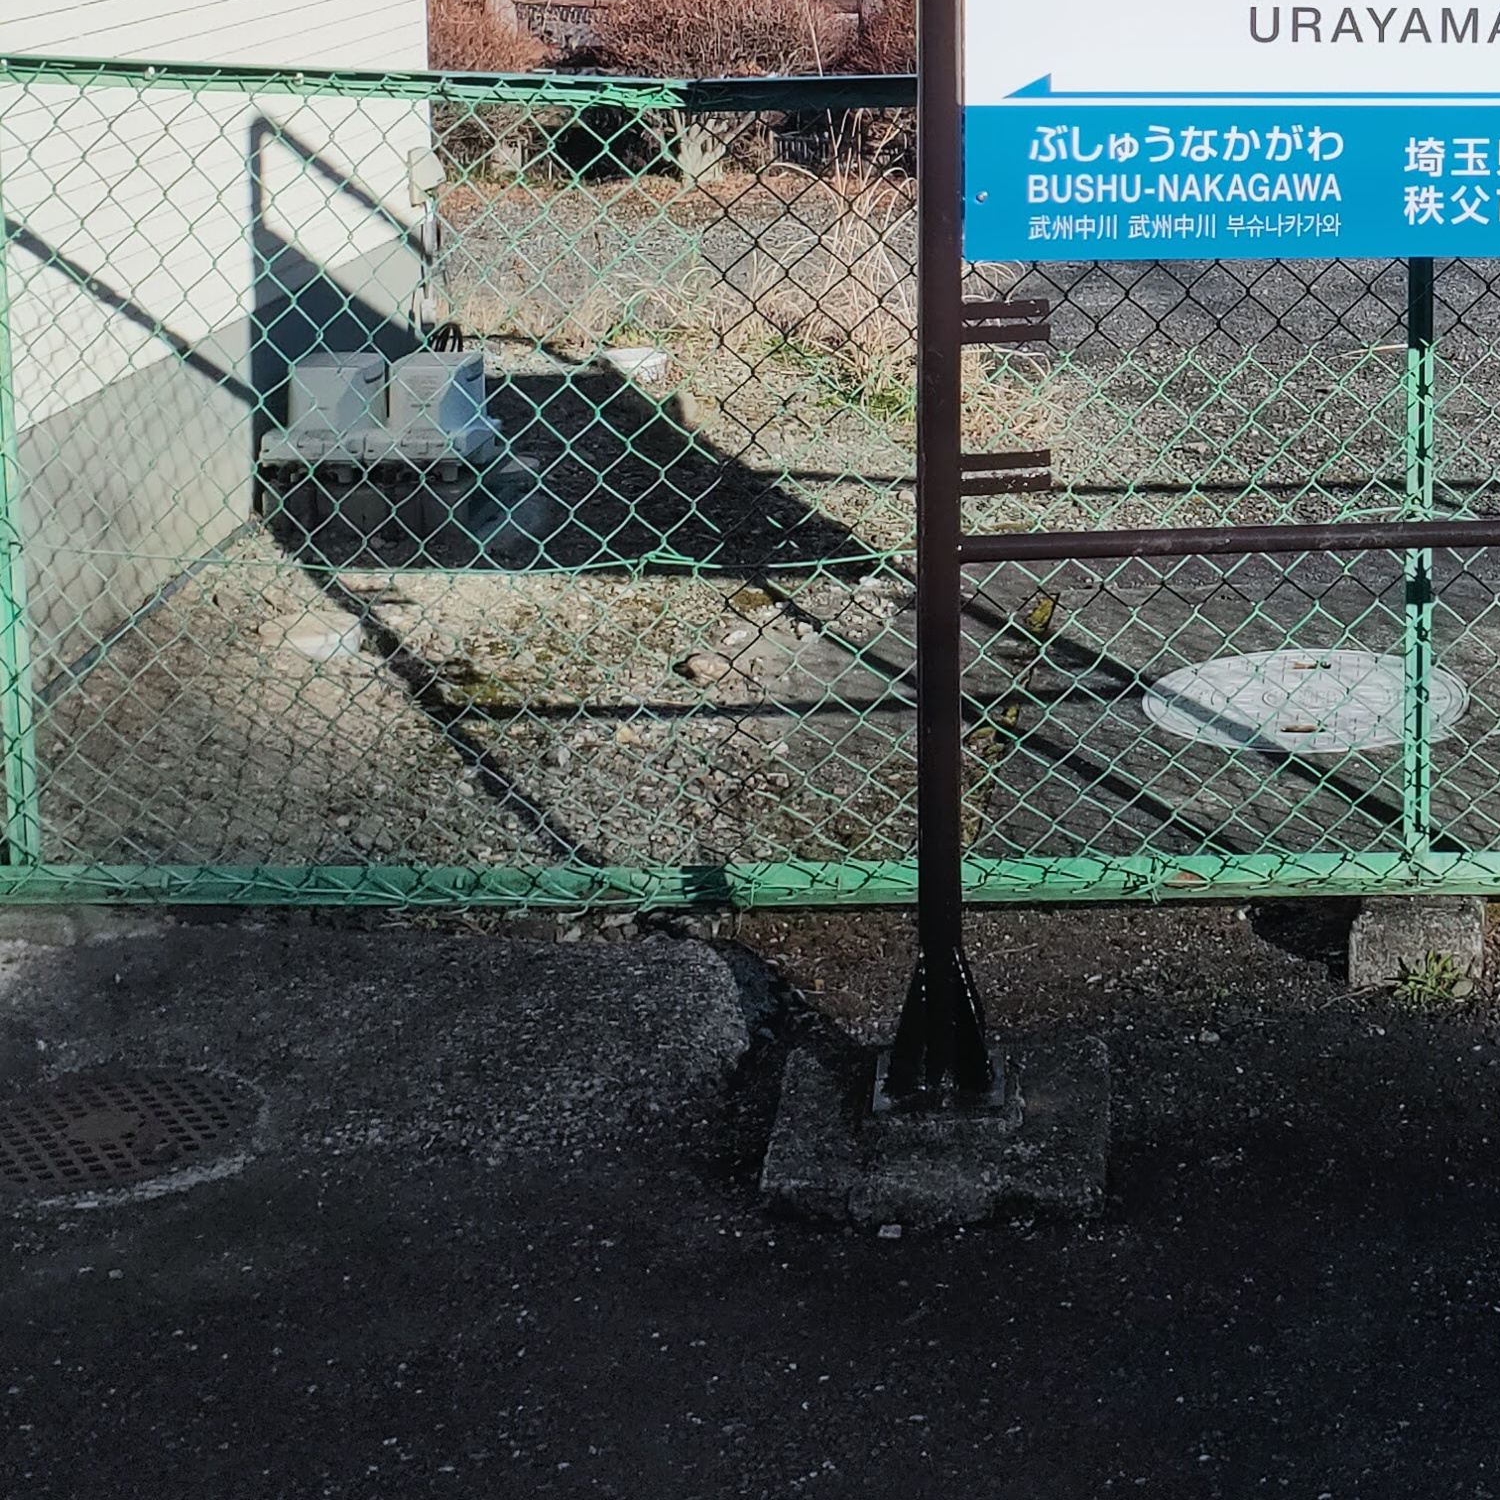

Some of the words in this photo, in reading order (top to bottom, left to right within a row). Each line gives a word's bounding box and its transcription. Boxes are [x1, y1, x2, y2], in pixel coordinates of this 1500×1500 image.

[1028, 124, 1344, 163] ぶしゅうなかがわ
[1027, 172, 1342, 204] BUSHU-NAKAGAWA
[1028, 214, 1118, 240] 武州中川
[1128, 213, 1216, 239] 武州中川
[1226, 213, 1342, 238] 부슈나카가와
